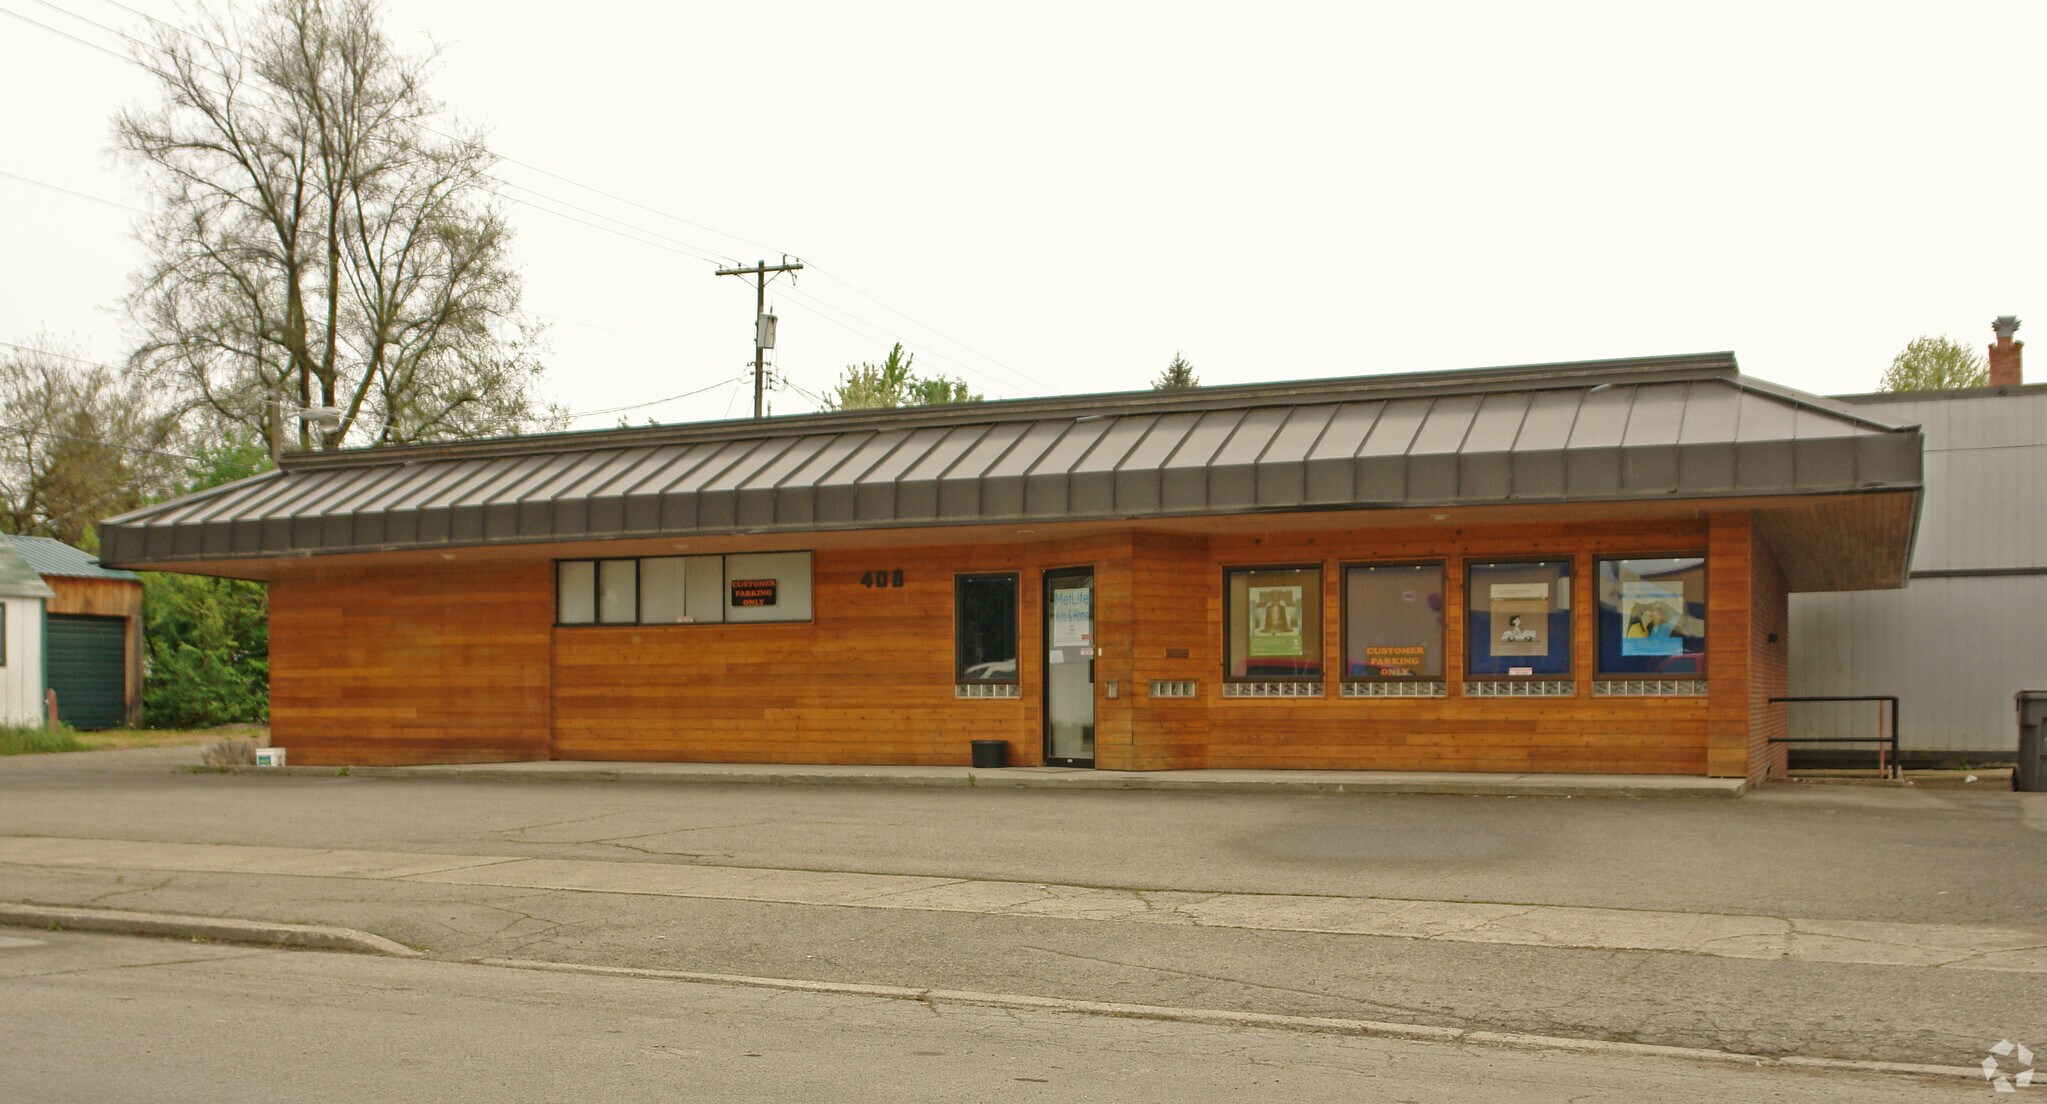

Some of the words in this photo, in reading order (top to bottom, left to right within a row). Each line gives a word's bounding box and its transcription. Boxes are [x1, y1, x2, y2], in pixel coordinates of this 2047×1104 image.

[861, 570, 903, 588] 408
[732, 580, 775, 588] CUSTOMER
[735, 589, 772, 597] PARKING
[1055, 592, 1089, 605] MetLife
[1367, 647, 1424, 655] CUSTOMER
[1371, 657, 1419, 665] PARKING
